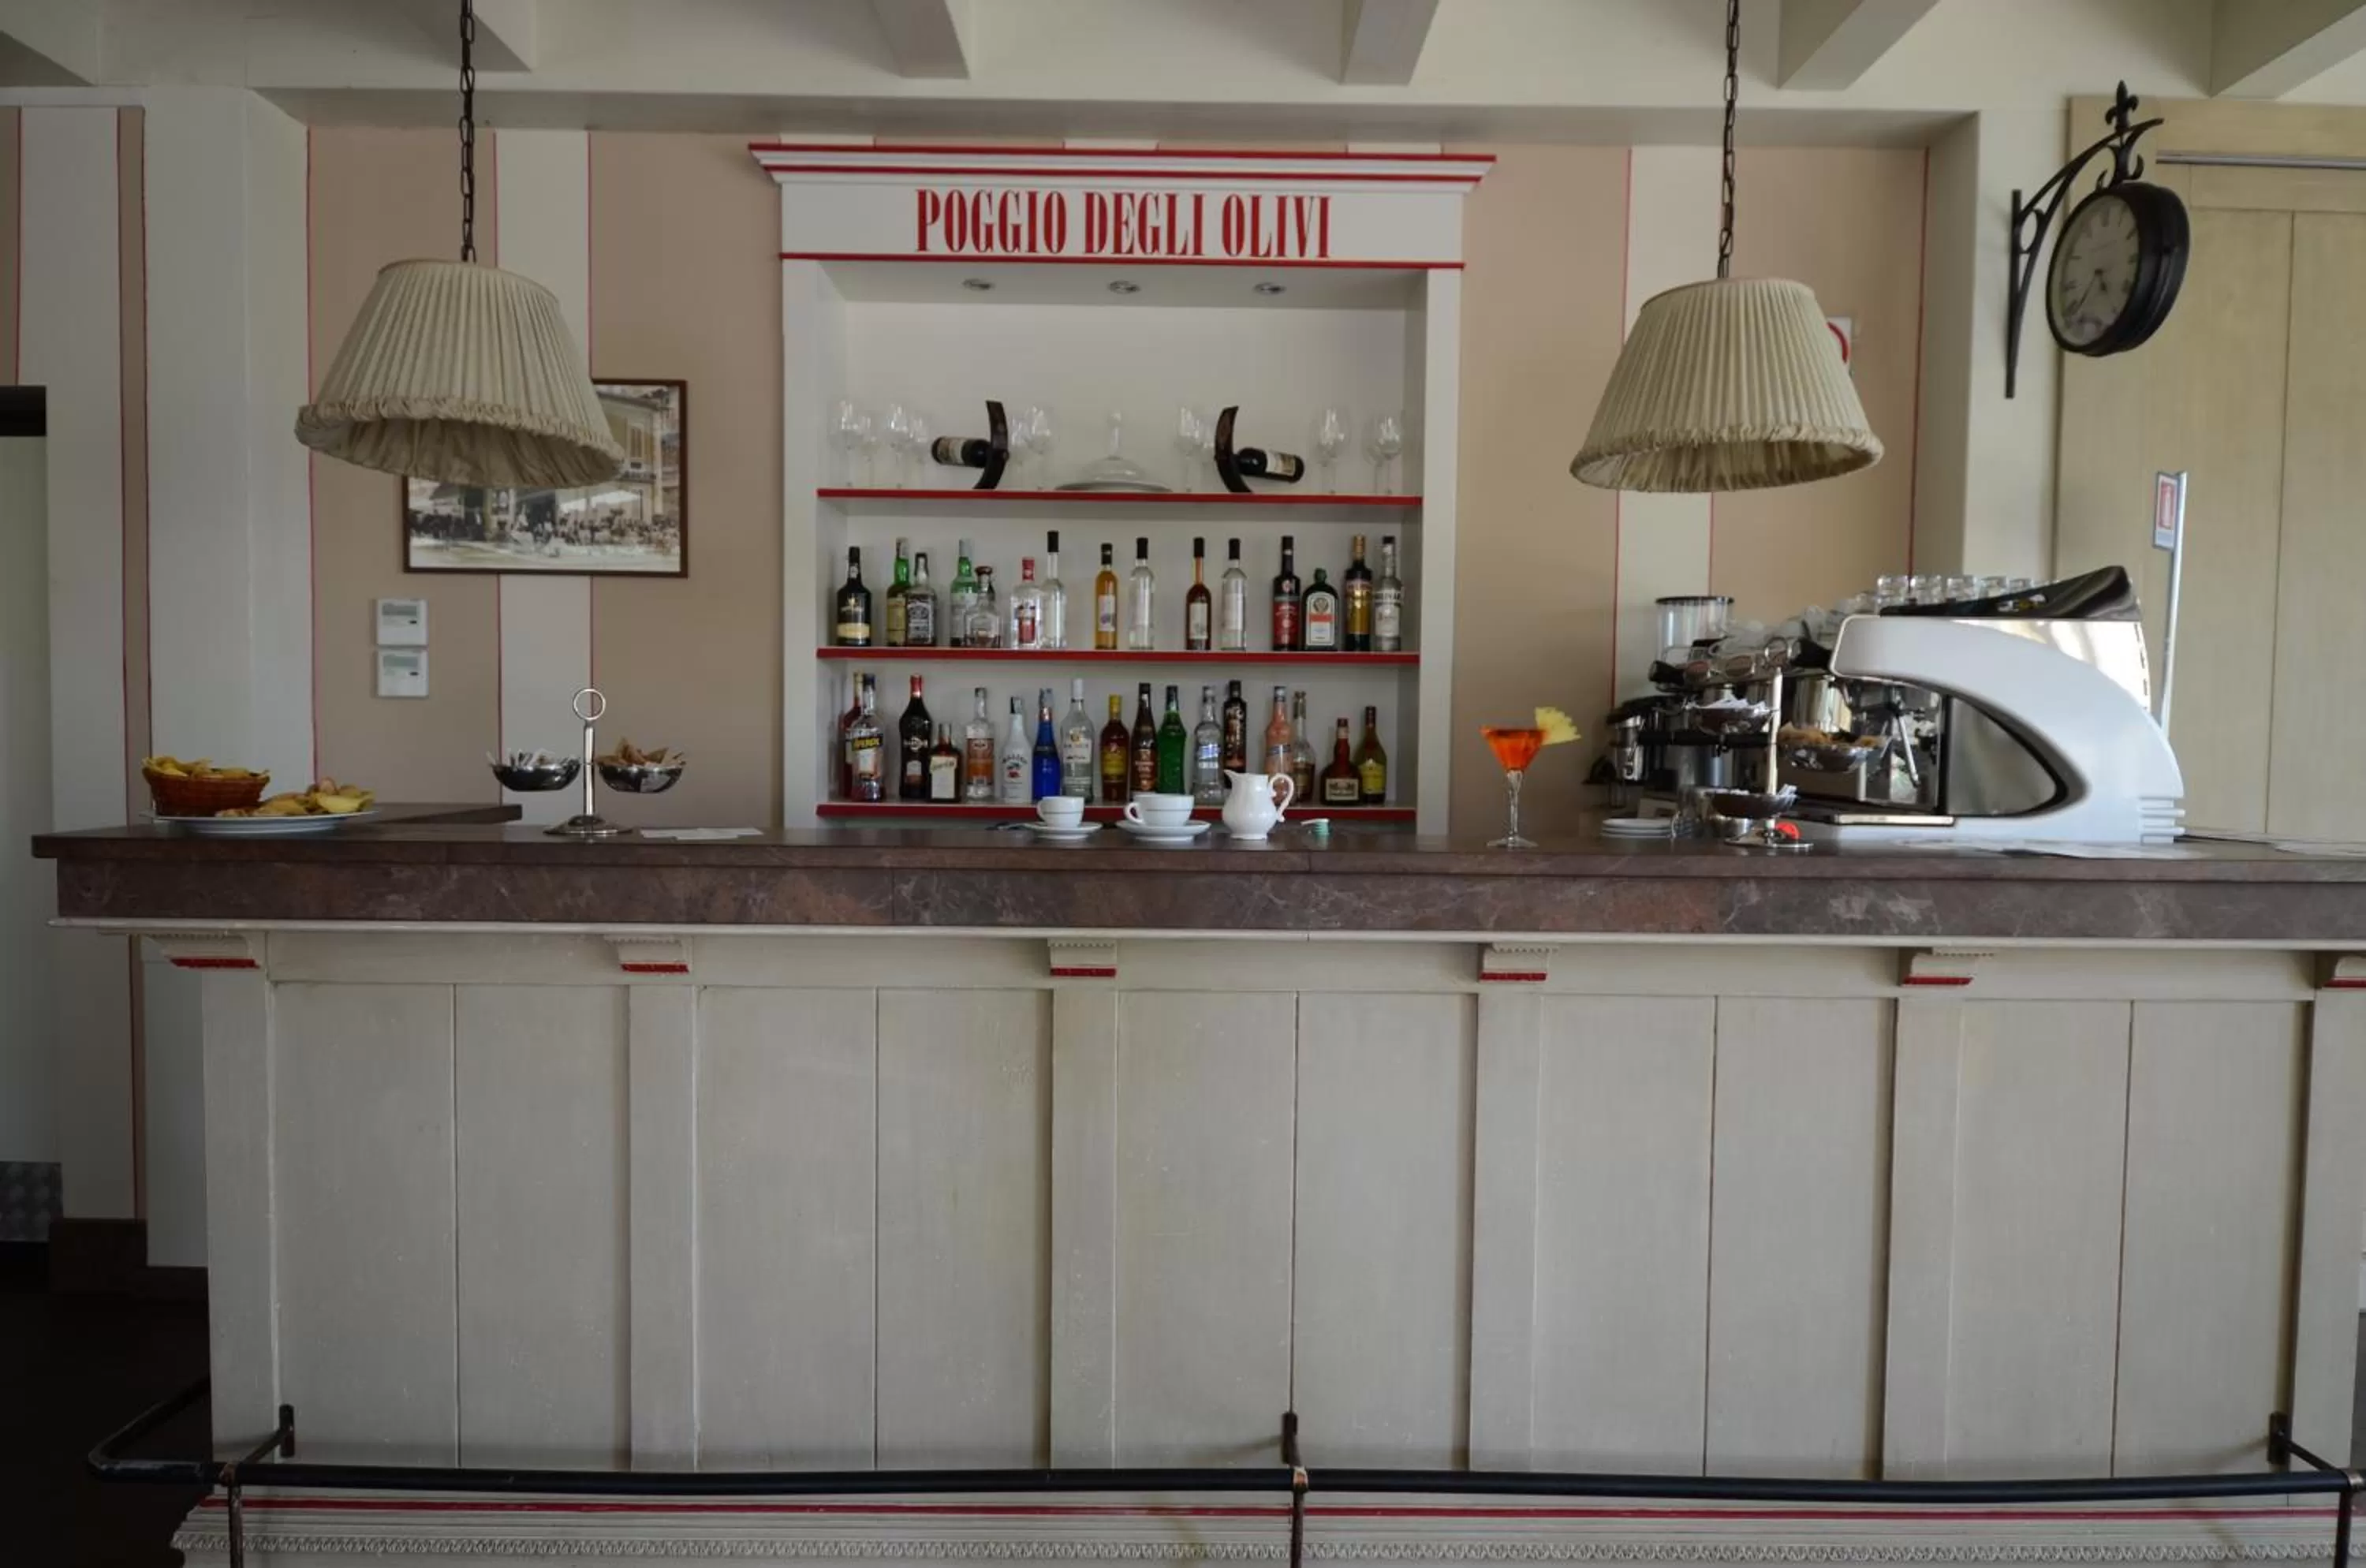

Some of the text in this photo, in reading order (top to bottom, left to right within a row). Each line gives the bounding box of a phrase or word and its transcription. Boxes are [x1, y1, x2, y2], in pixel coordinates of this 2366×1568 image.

[915, 189, 1333, 259] POGGIO DEGLI OLIVI
